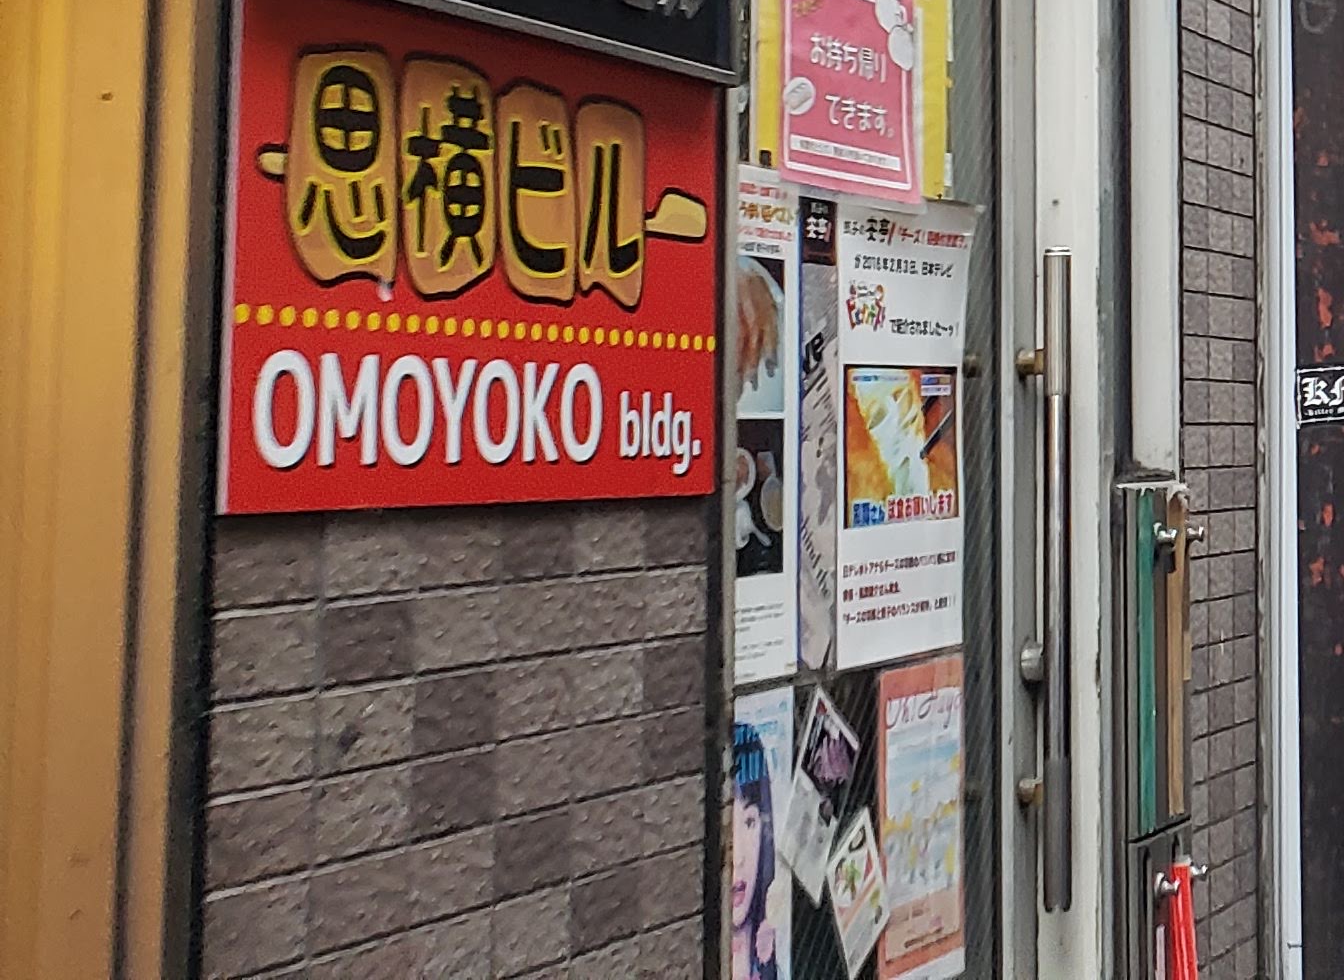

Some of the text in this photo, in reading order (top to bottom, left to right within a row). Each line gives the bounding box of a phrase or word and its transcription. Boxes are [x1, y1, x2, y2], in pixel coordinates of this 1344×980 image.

[810, 33, 887, 83] お持ち帰り
[825, 96, 895, 138] できます。
[253, 349, 603, 470] OMOYOKO
[619, 390, 702, 476] bldg.
